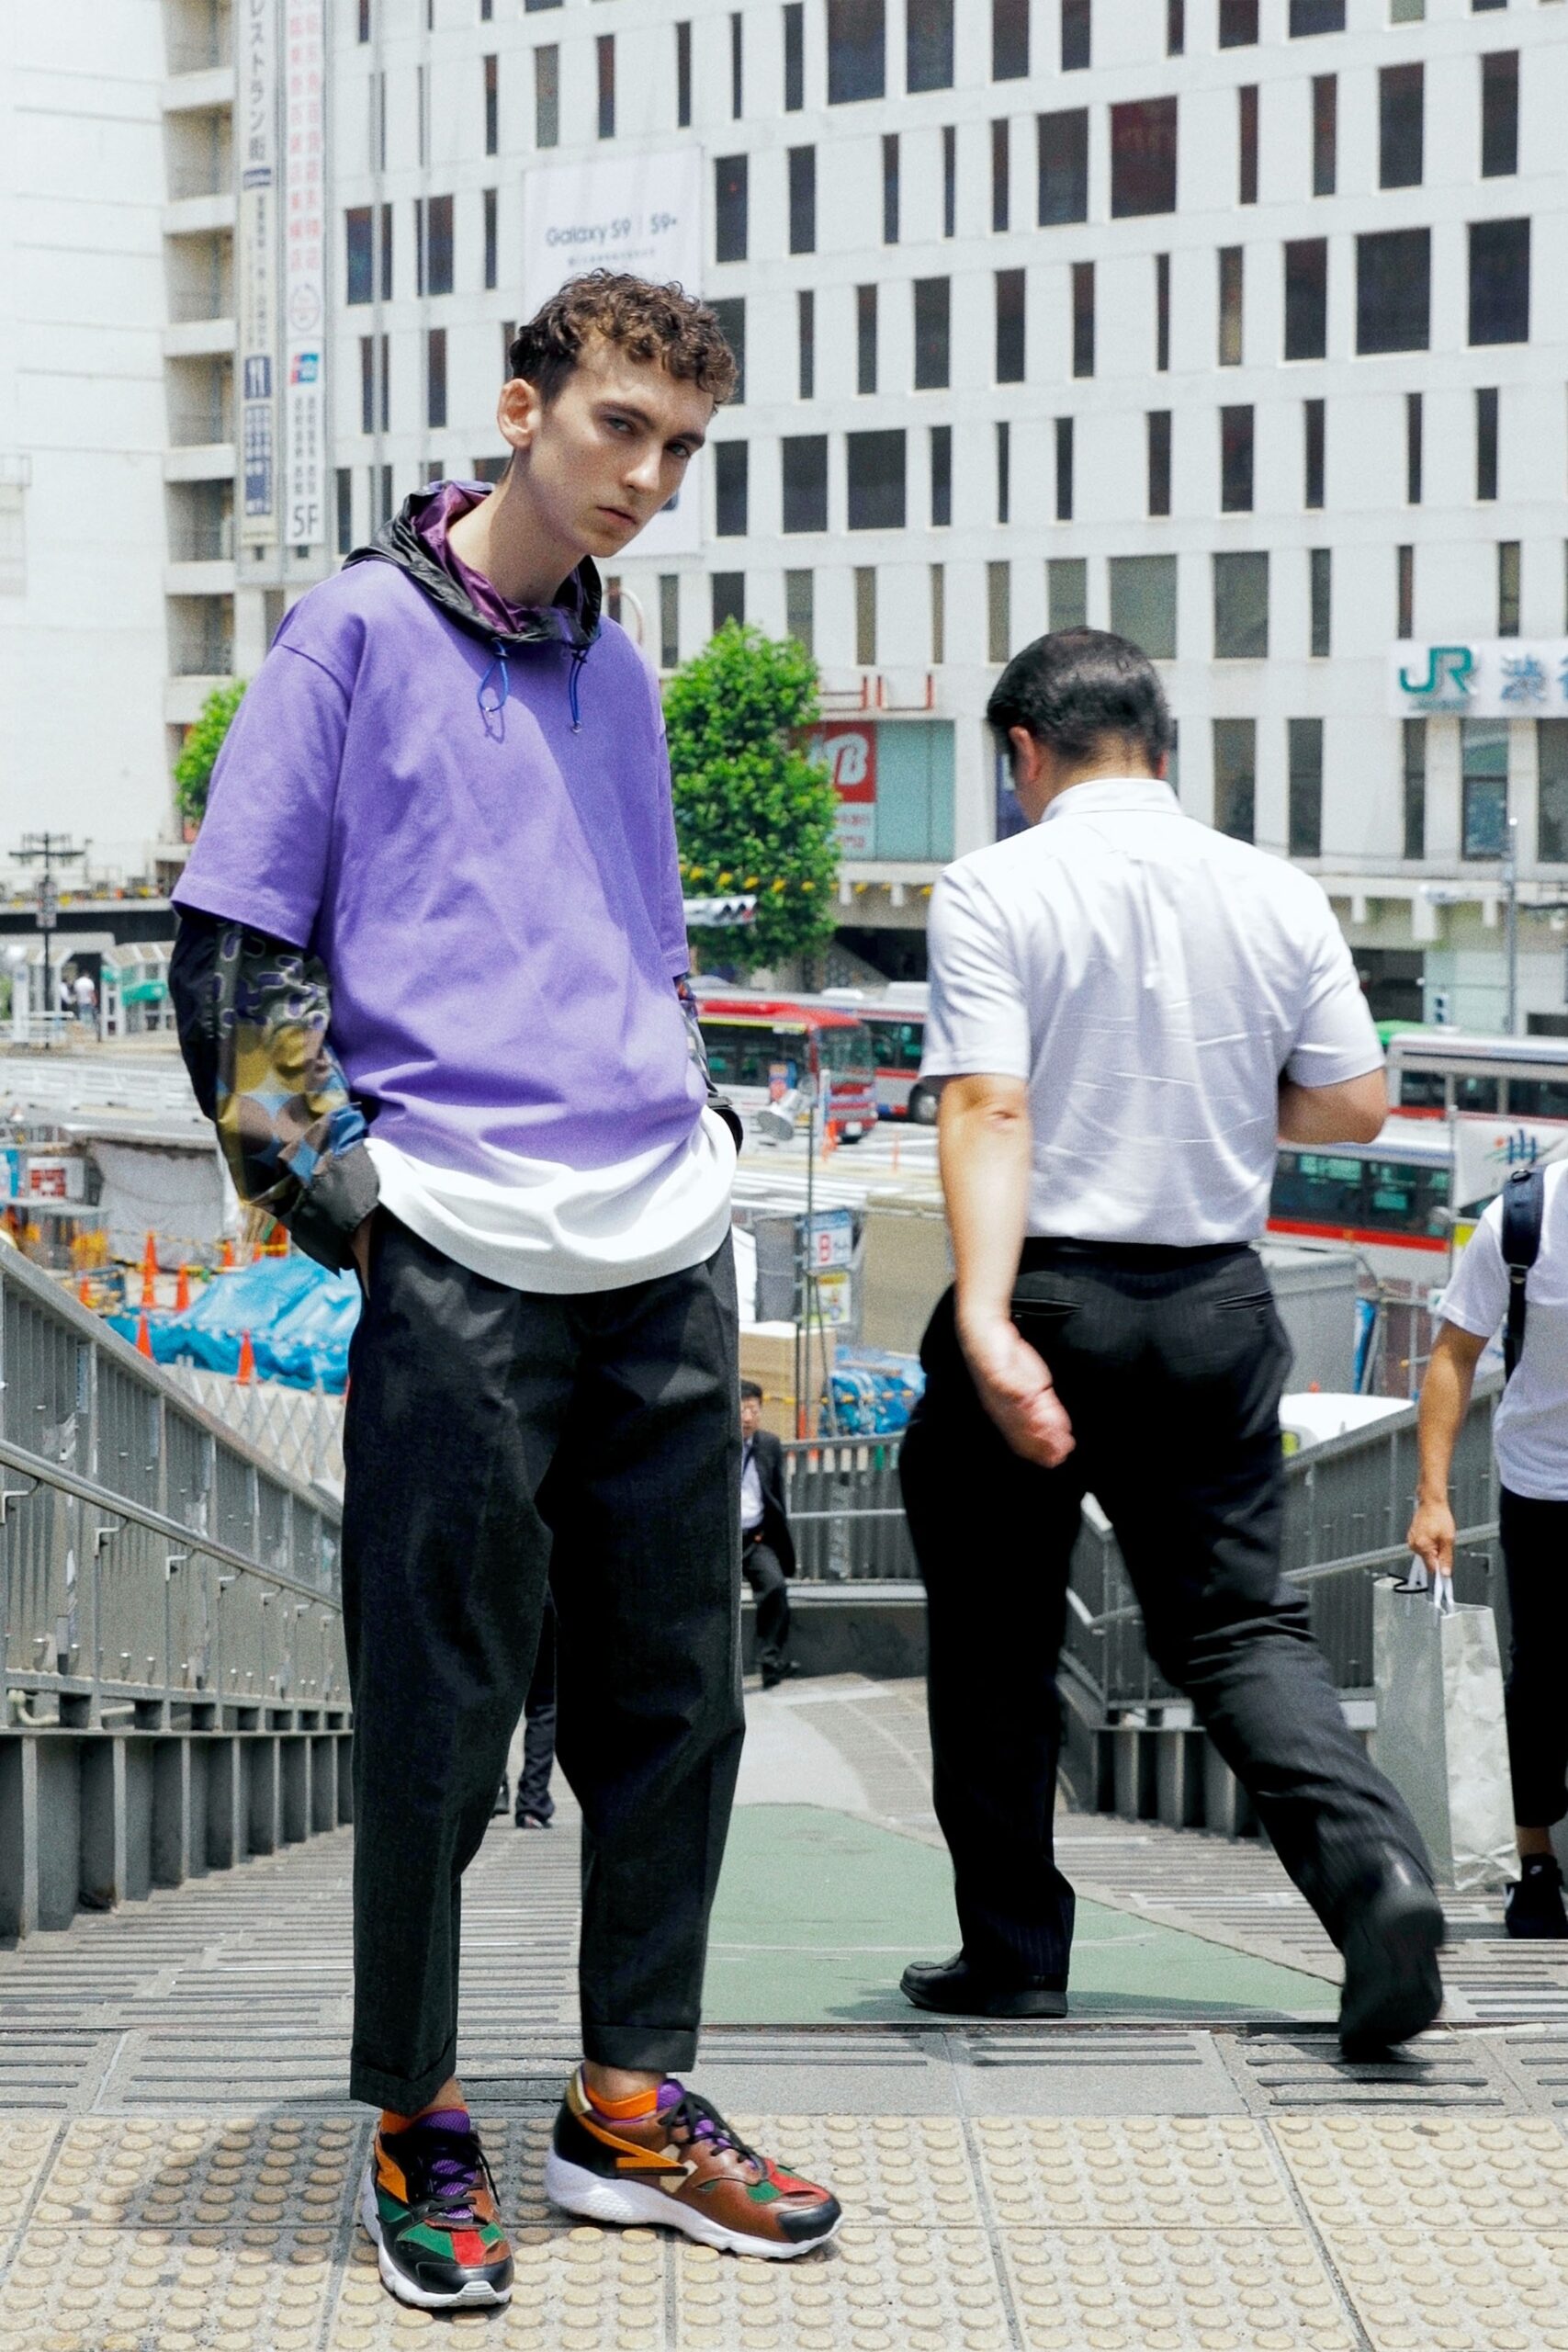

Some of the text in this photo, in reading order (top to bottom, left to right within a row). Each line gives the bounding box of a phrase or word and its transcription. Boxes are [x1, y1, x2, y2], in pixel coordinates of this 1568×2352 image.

[546, 226, 606, 246] Galaxy
[611, 218, 632, 240] S9
[1399, 646, 1473, 694] JR
